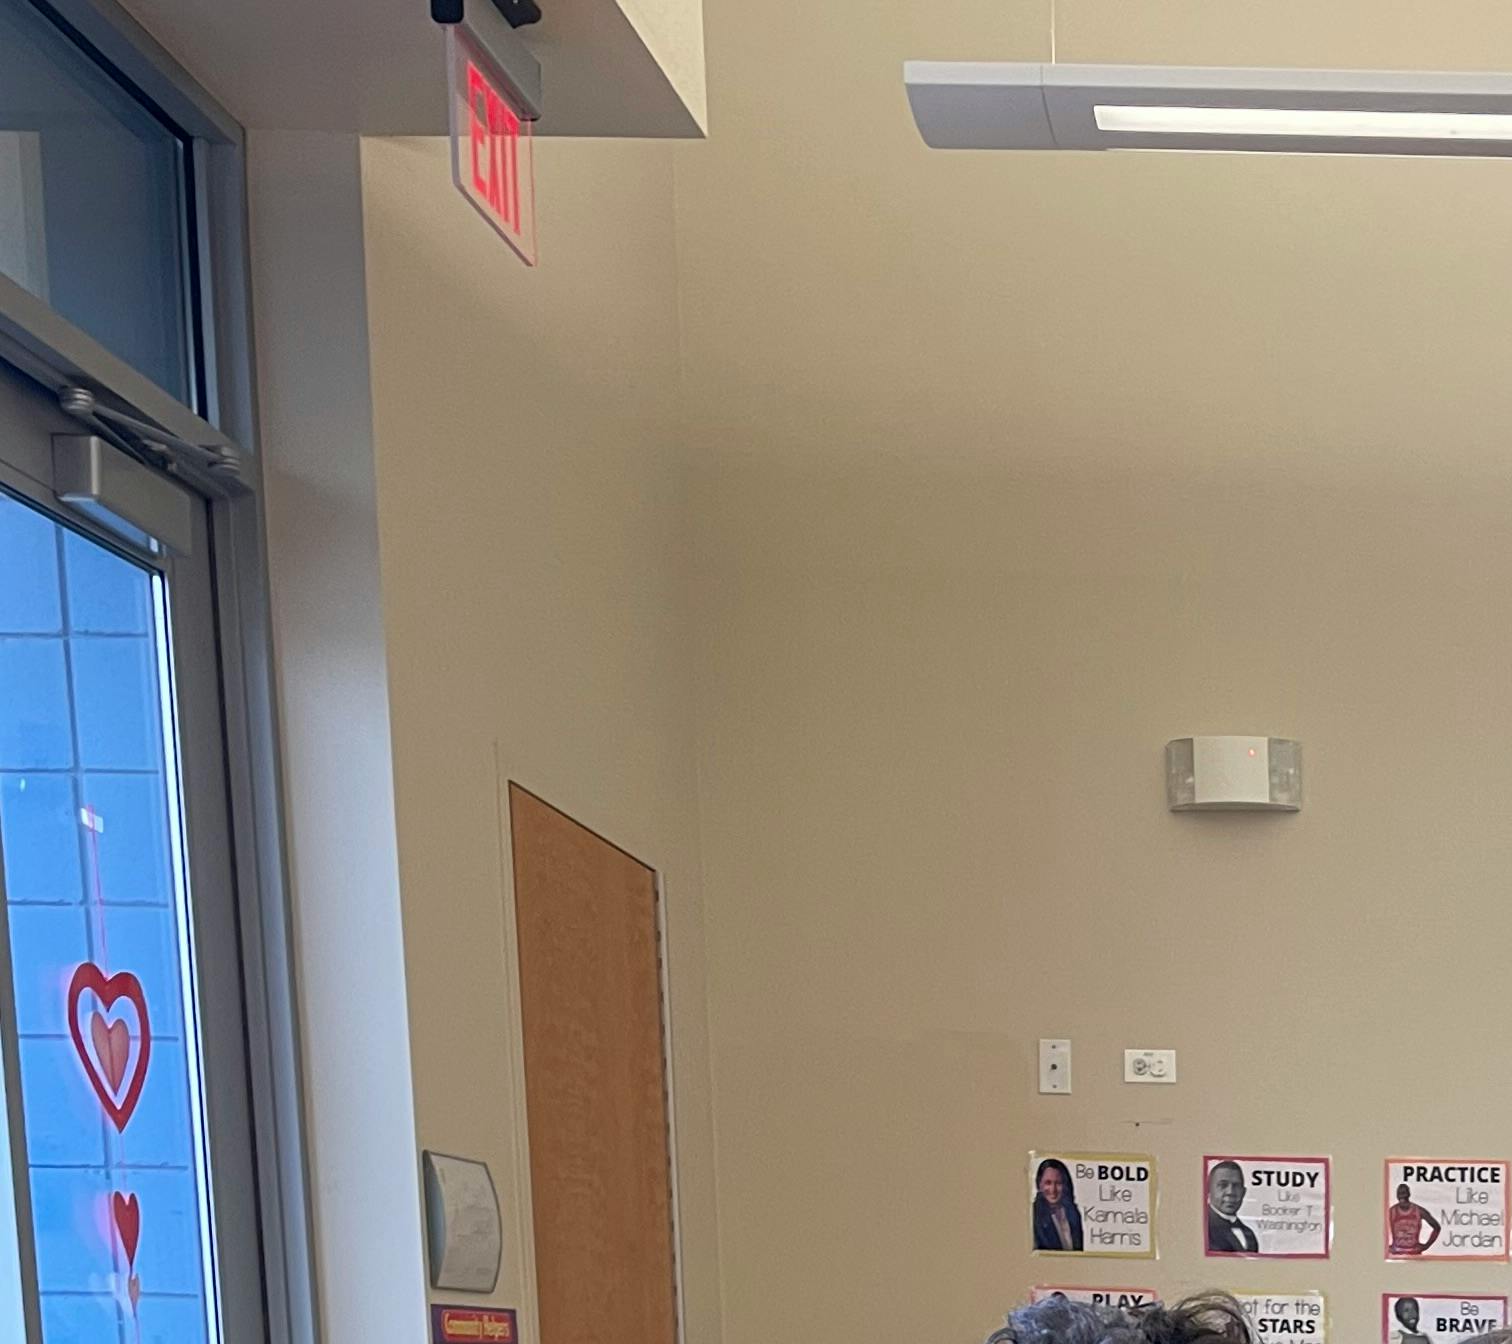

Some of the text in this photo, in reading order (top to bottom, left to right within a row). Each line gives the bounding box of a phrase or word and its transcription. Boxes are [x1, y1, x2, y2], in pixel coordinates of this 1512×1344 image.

[467, 60, 521, 237] EXIT
[1075, 1163, 1149, 1182] Be BOLD
[1251, 1170, 1319, 1188] STUDY
[1402, 1166, 1501, 1184] PRACTICE
[1098, 1184, 1132, 1202] Like
[1456, 1187, 1489, 1205] Like
[1083, 1205, 1148, 1225] Kamala
[1441, 1209, 1504, 1227] Michael
[1090, 1227, 1142, 1247] Harris
[1442, 1231, 1503, 1248] Jordan
[1265, 1299, 1289, 1315] for
[1294, 1299, 1321, 1316] the
[1460, 1301, 1480, 1316] Be
[1258, 1318, 1316, 1334] STARS
